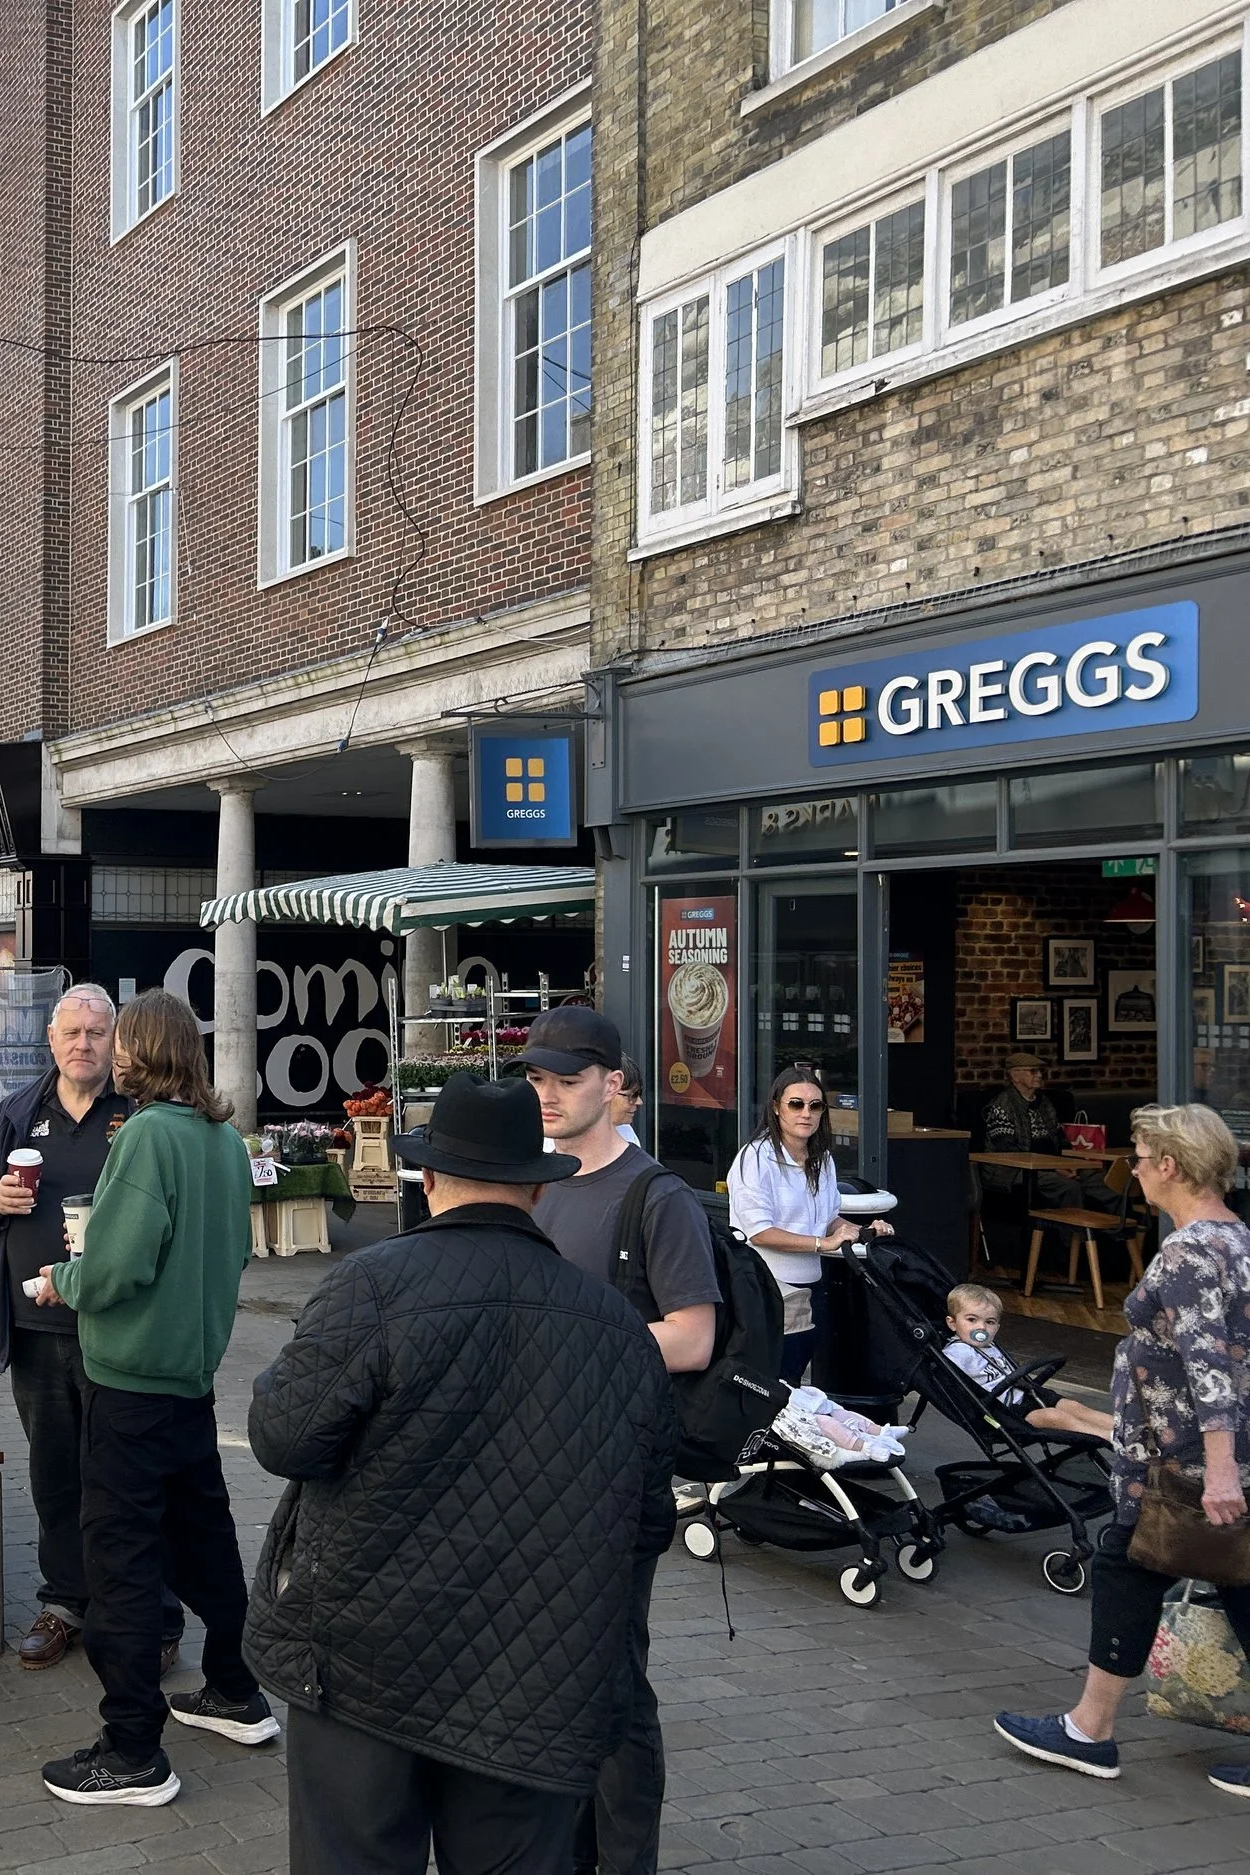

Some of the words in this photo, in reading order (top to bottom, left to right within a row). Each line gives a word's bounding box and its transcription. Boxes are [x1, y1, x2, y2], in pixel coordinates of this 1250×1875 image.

[877, 631, 1170, 736] GREGGS
[506, 809, 546, 818] GREGGS
[687, 910, 713, 919] GREGGS
[668, 927, 728, 949] AUTUMN
[668, 948, 728, 964] SEASONING
